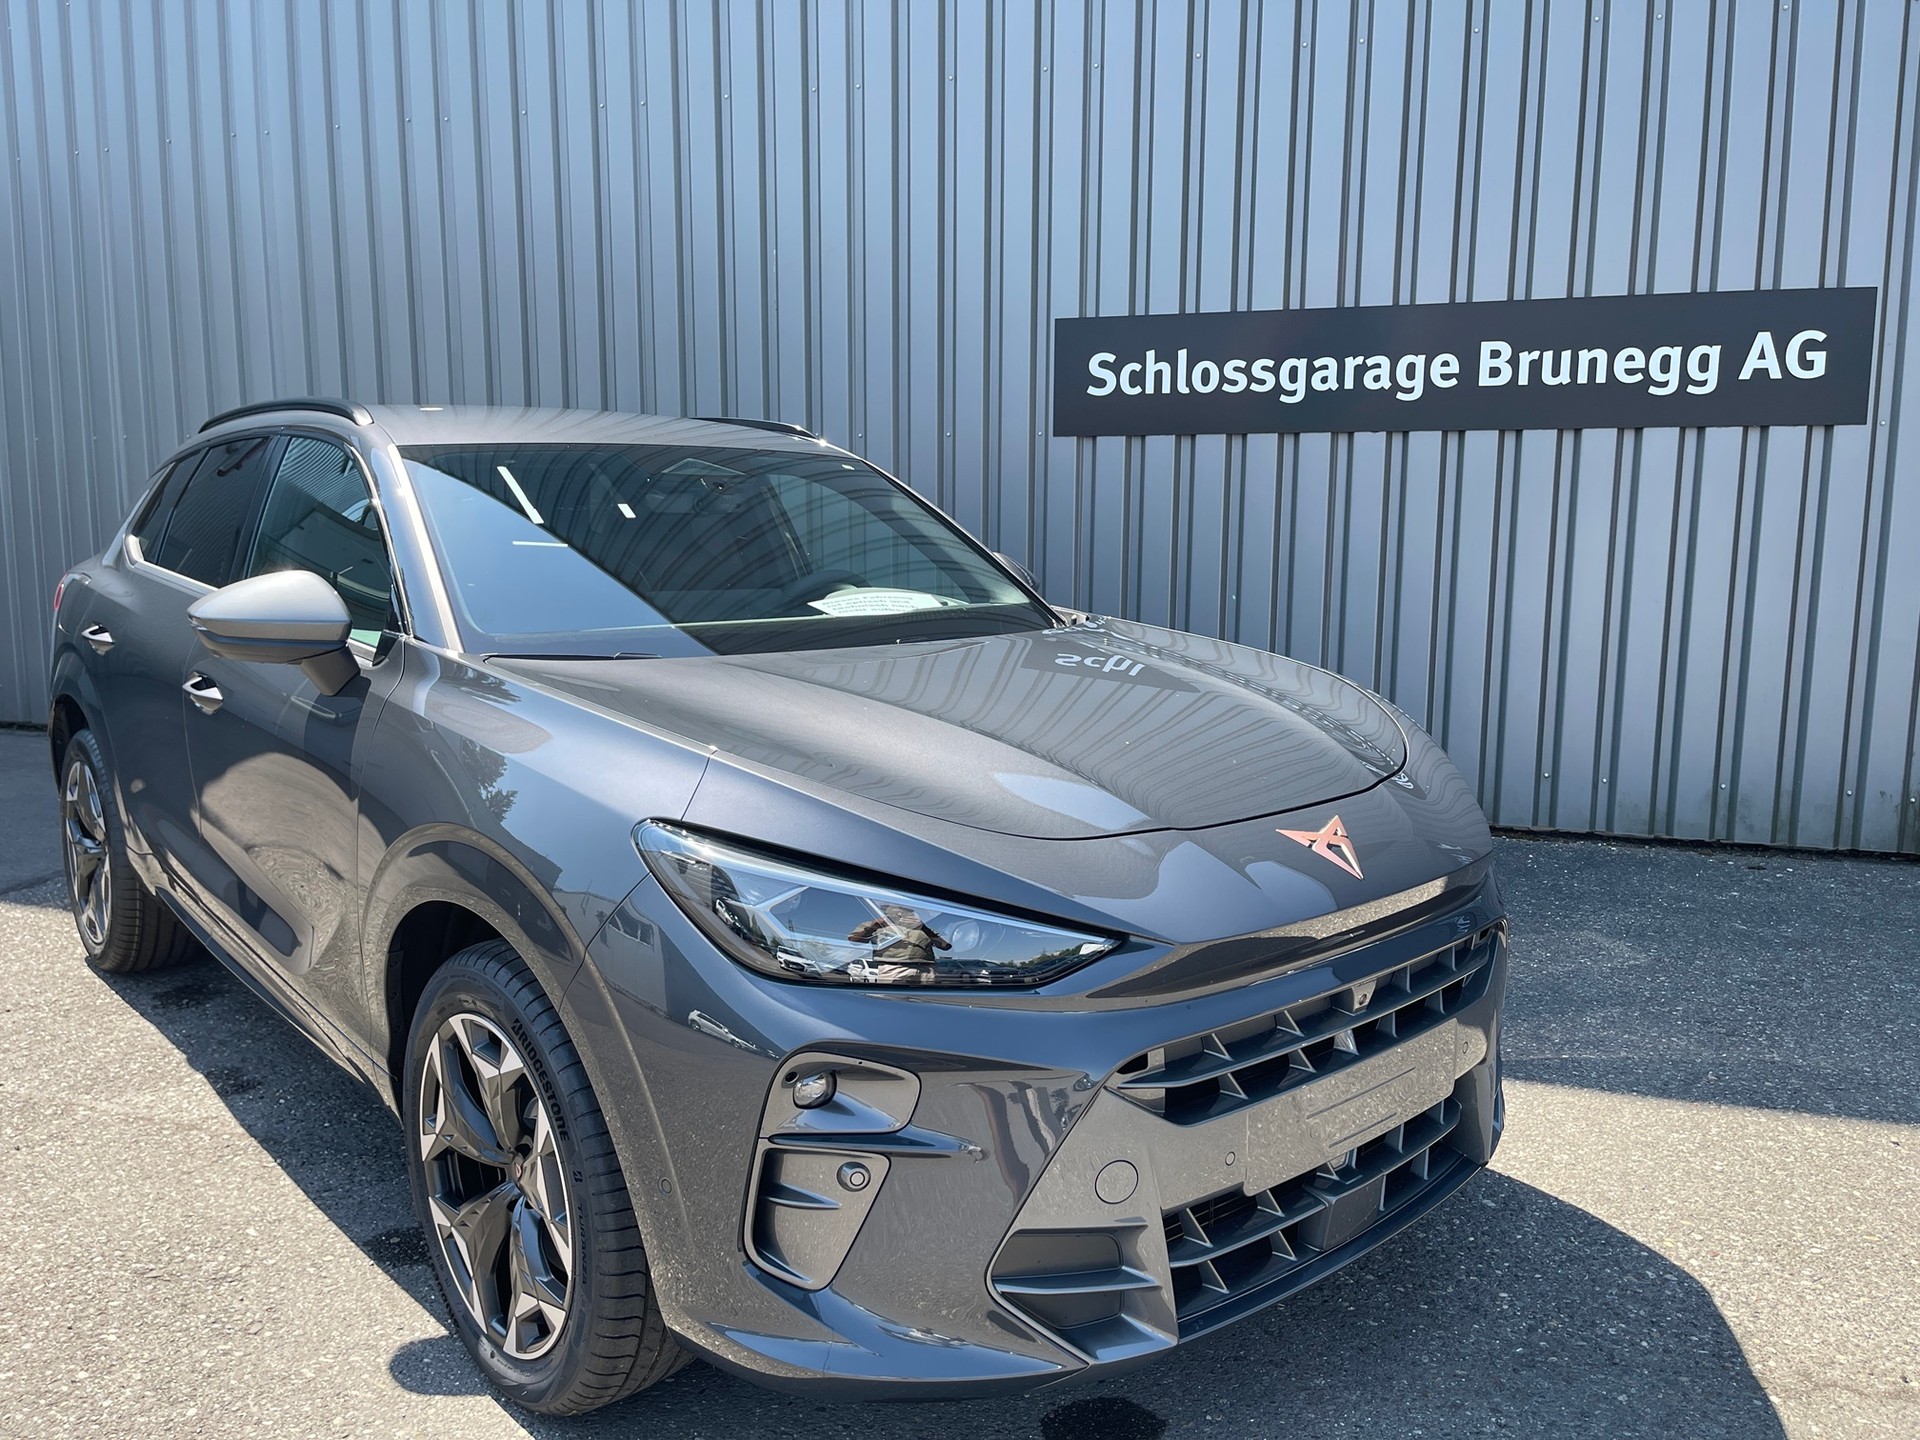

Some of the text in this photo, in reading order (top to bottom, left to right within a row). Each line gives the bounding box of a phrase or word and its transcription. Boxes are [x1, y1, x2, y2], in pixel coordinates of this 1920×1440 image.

[1086, 329, 1828, 405] Schlossgarage Brunegg AG
[511, 1017, 570, 1142] BRIDGESTONE
